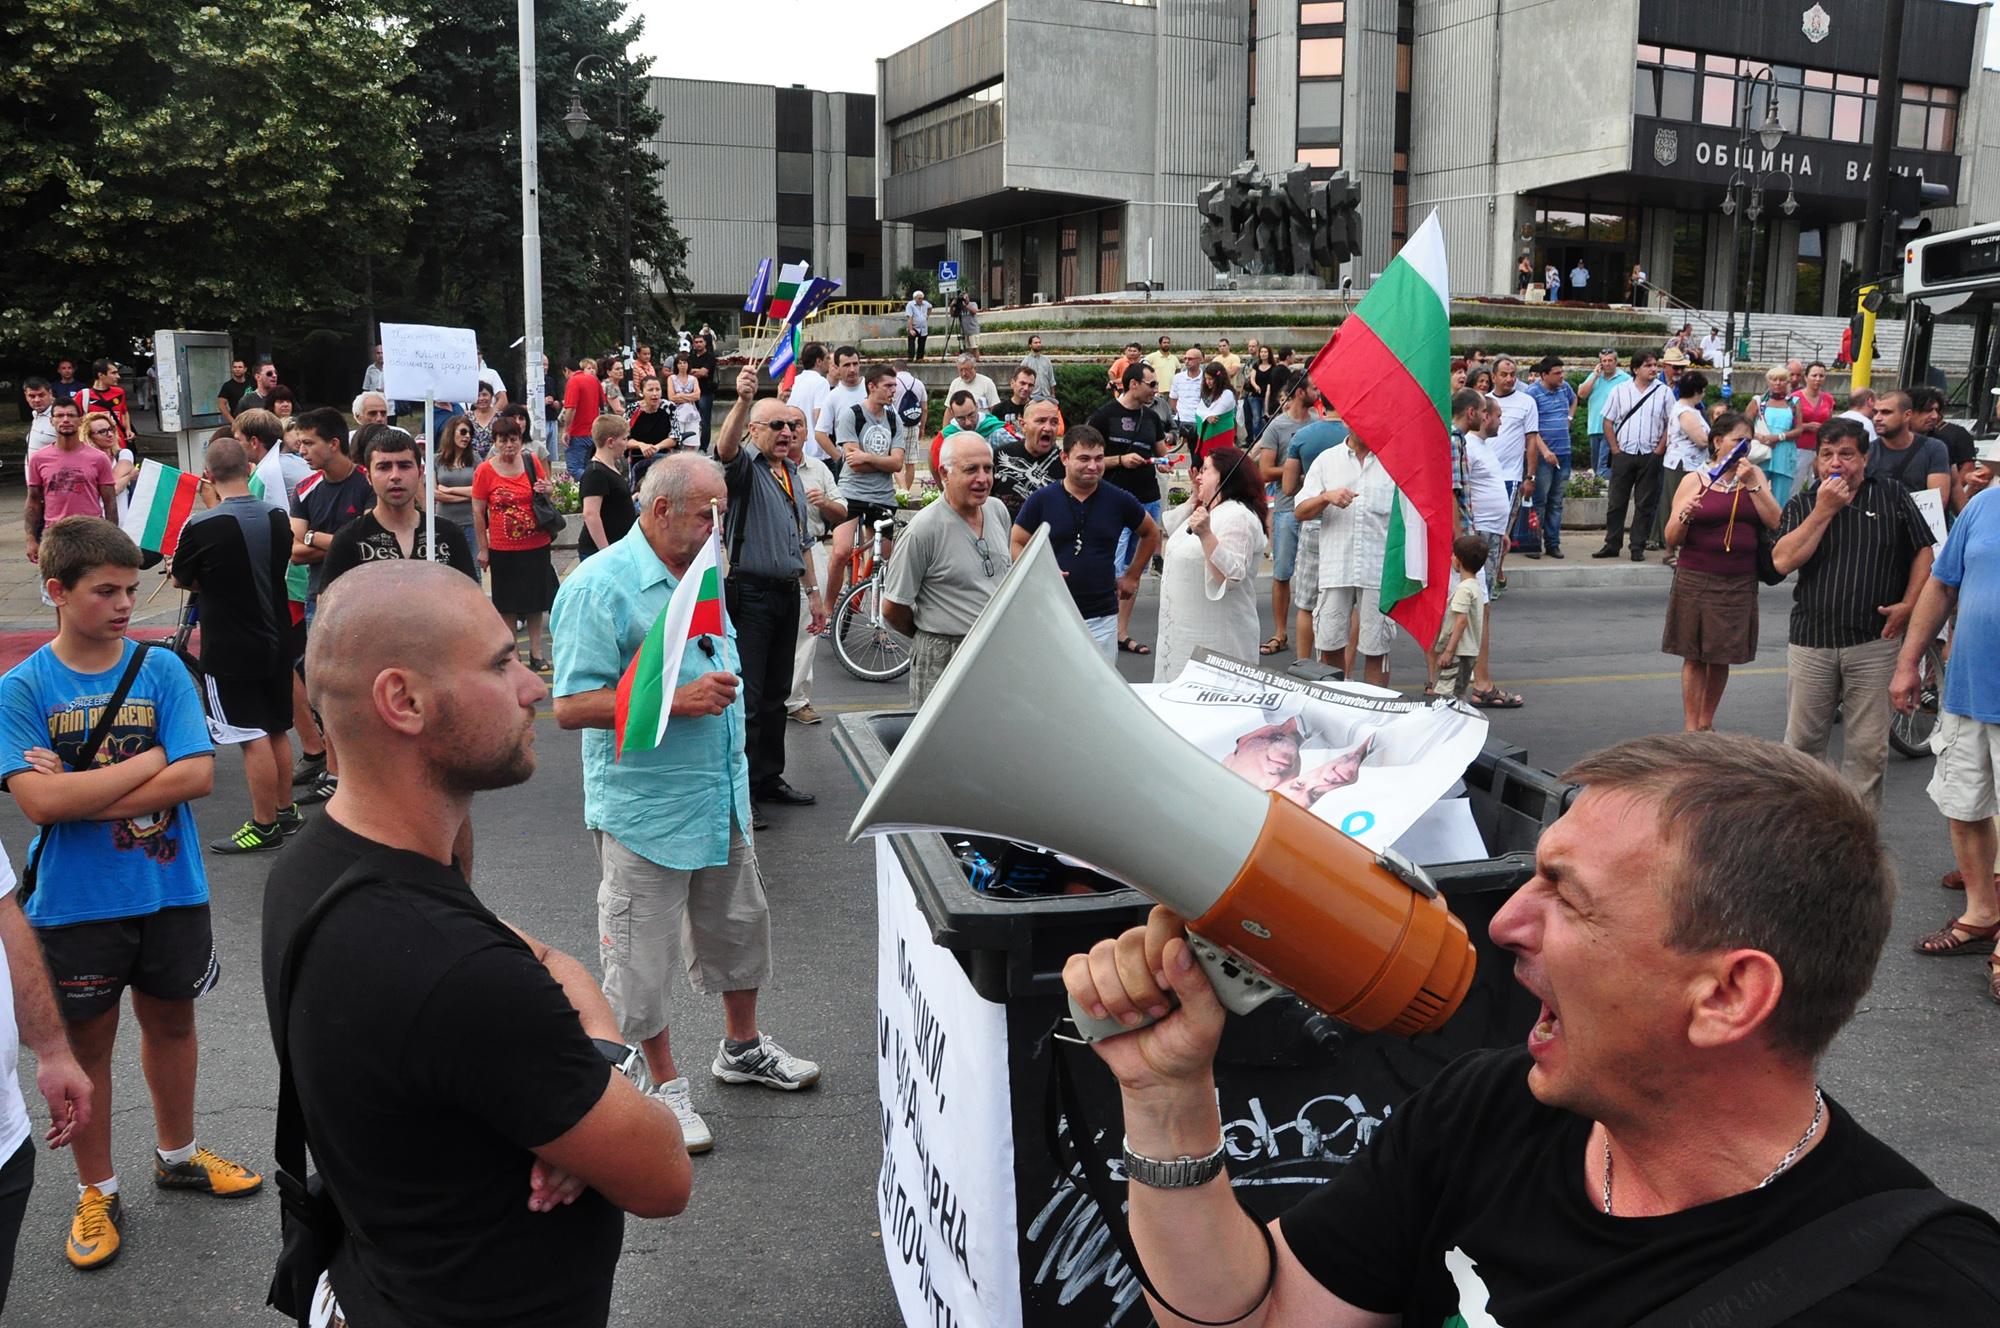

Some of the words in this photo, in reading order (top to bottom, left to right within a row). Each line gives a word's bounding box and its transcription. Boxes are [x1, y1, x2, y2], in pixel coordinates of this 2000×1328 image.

[1695, 141, 1812, 176] ОБЩИНА
[1205, 653, 1264, 682] ПРЕСТЪПЛЕНИЕ
[1272, 676, 1309, 696] ГЛАСОВЕ
[1310, 687, 1321, 697] НА
[1321, 690, 1376, 710] ПРОДАВАНЕТО
